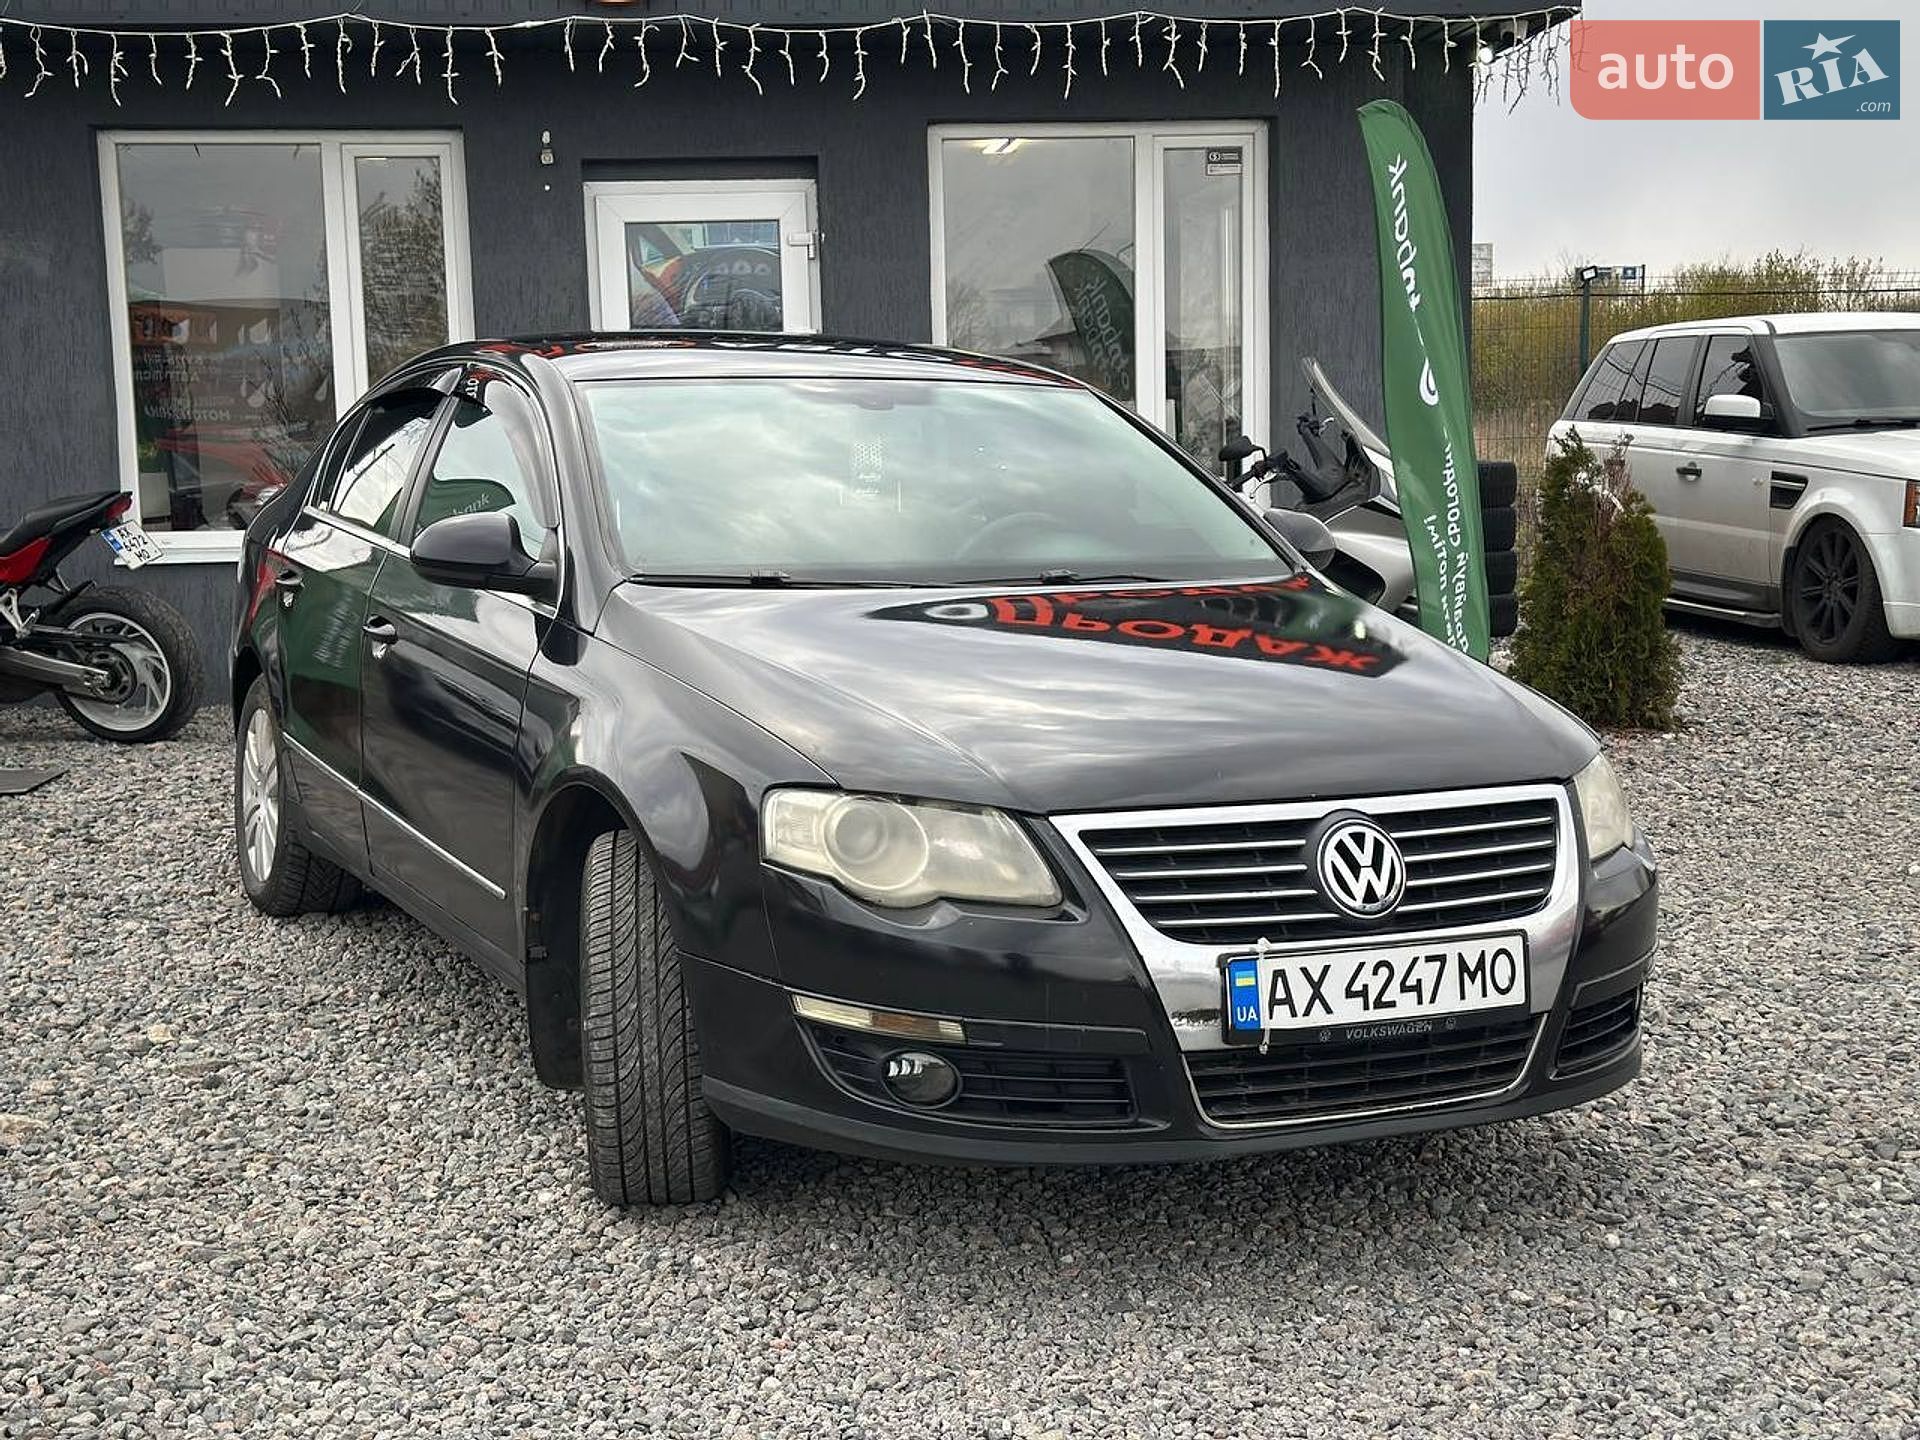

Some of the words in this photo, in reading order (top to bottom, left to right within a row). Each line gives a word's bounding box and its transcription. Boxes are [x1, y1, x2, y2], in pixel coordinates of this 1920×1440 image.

[1236, 1004, 1259, 1022] UA
[1267, 964, 1334, 1020] AX
[1344, 953, 1448, 1011] 4247
[1457, 947, 1516, 1001] MO
[1345, 1020, 1434, 1041] VOLKSWAGEN
